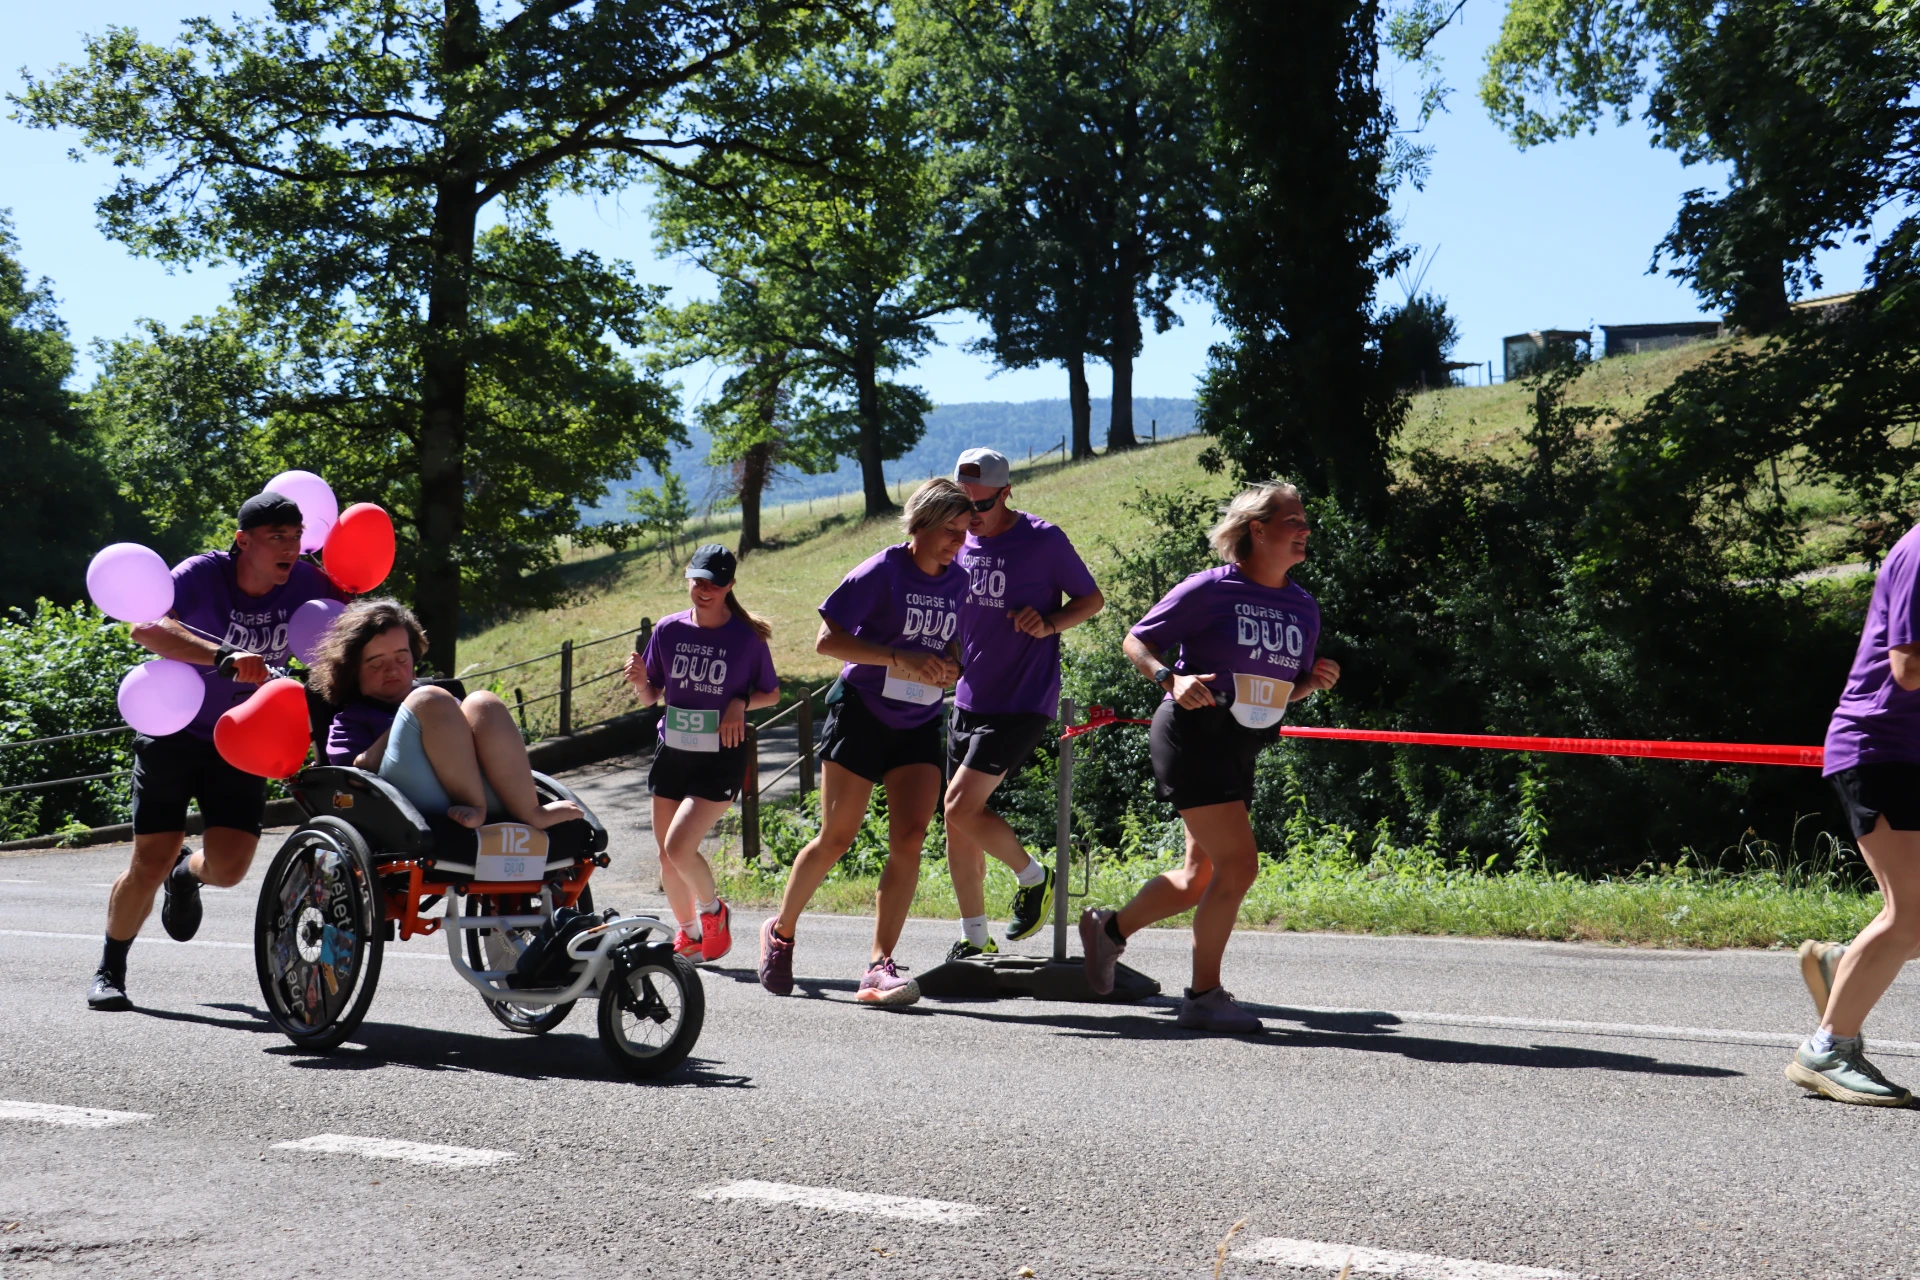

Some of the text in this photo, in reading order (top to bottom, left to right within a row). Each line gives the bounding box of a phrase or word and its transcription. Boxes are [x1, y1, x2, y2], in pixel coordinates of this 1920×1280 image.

[962, 554, 992, 567] COURSE
[905, 593, 945, 608] COURSE
[978, 596, 1005, 608] SUISSE
[1234, 603, 1284, 620] COURSE
[902, 607, 957, 641] DUO
[222, 622, 289, 653] DUO
[1237, 616, 1303, 657] DUO
[675, 642, 714, 656] COURSE
[671, 654, 727, 685] DUO
[1267, 653, 1301, 670] SUISSE
[693, 682, 724, 695] SUISSE
[1250, 679, 1274, 705] 110
[676, 711, 704, 731] 59
[1548, 738, 1653, 755] RAIFFEISEN
[500, 826, 531, 854] 112
